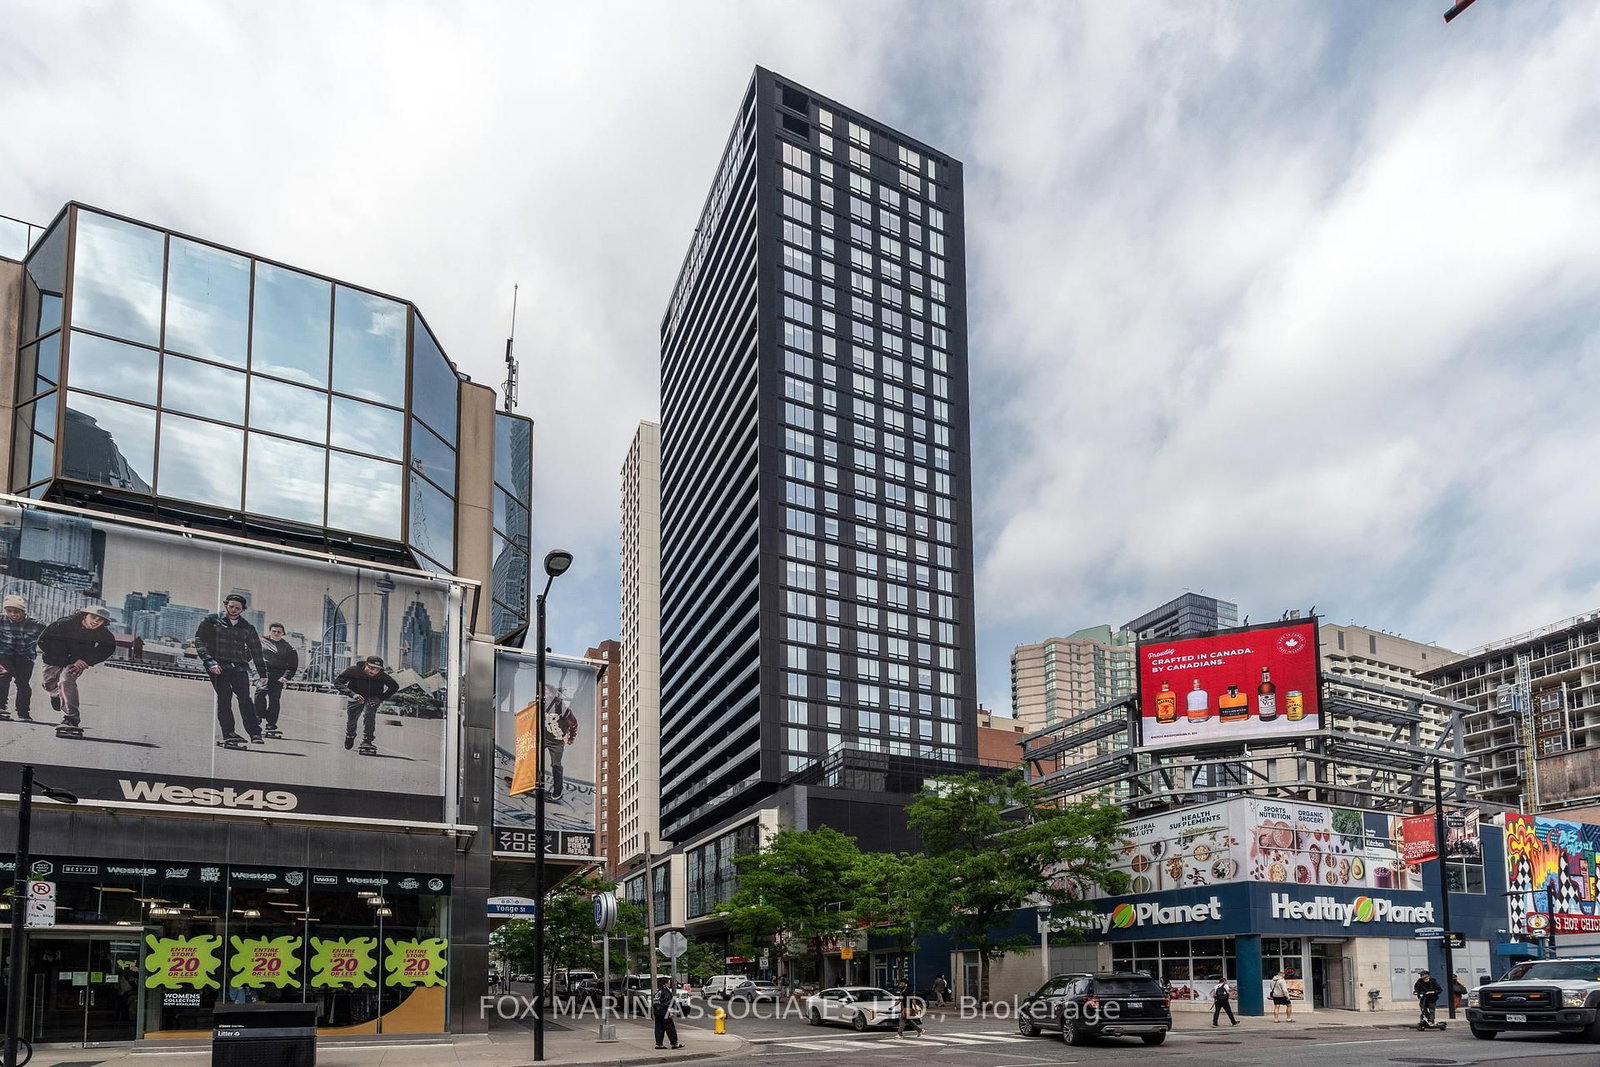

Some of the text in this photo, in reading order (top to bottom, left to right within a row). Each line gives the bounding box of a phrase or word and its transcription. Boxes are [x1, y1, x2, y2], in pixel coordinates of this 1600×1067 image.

[1148, 648, 1176, 660] Proudly
[1152, 656, 1195, 666] CRAFTED
[1210, 648, 1254, 658] CANADA.
[1166, 660, 1226, 672] CANADIANS.
[118, 780, 298, 811] West49
[1182, 811, 1210, 821] HEALTH
[1259, 812, 1291, 820] NUTRITION
[1264, 806, 1286, 814] SPORTS
[1298, 810, 1323, 818] ORGANIC
[1170, 814, 1220, 830] SUPPLEMENTS
[1366, 839, 1384, 847] Kitchen
[107, 867, 157, 875] West49
[1137, 897, 1222, 926] Planet
[1271, 893, 1435, 926] Healthy Planet
[1563, 917, 1579, 930] HOT
